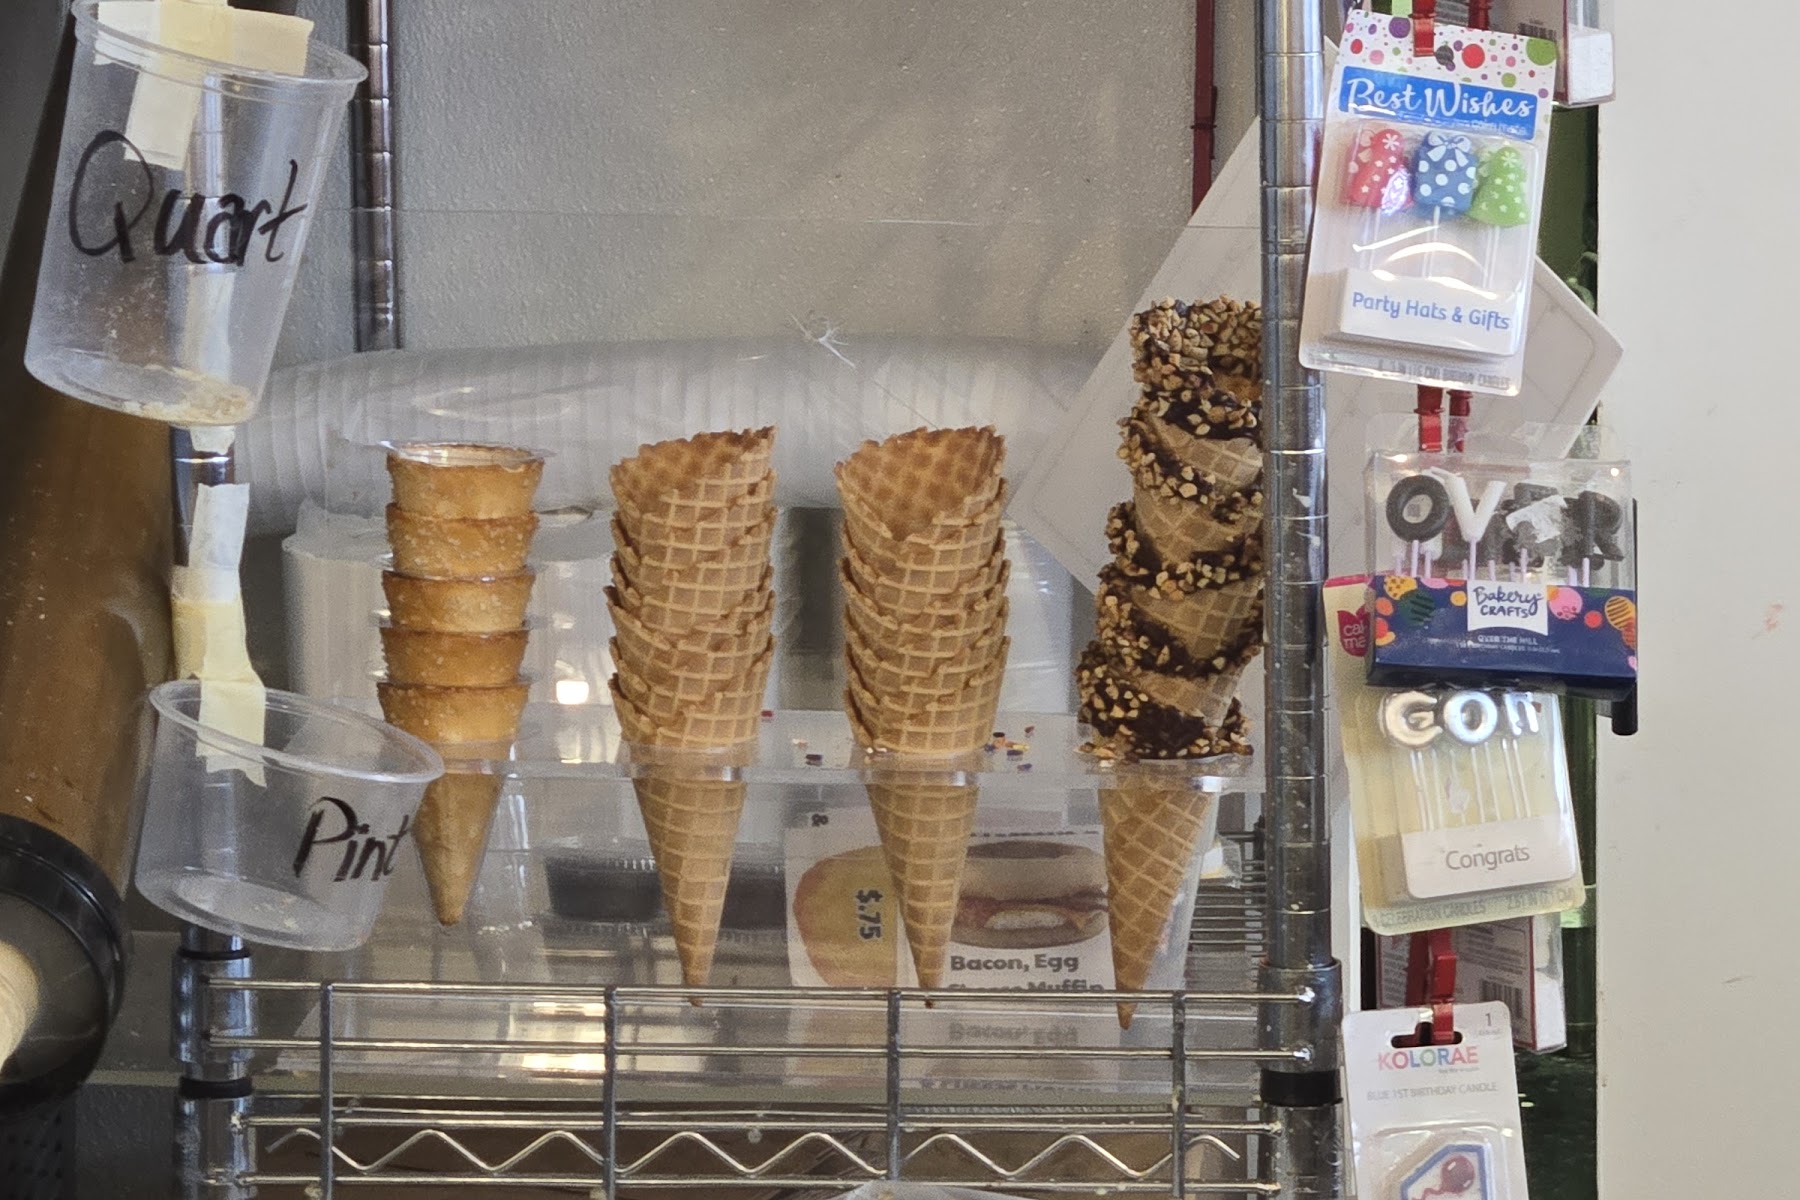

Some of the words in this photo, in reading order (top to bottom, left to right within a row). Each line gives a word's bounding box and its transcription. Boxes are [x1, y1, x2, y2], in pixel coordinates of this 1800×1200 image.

[1347, 77, 1423, 111] Best
[1424, 82, 1535, 117] Wishes
[69, 130, 309, 267] Quart
[1352, 291, 1401, 318] Party
[1406, 299, 1447, 323] Hats
[1451, 306, 1463, 323] &
[1468, 308, 1510, 330] Gifts
[1473, 586, 1543, 616] Bakery
[1480, 605, 1530, 618] CRAFTS
[293, 796, 411, 882] Pint
[1445, 845, 1530, 871] Congrats
[855, 889, 883, 940] $.75
[950, 955, 1030, 973] Bacon,
[1034, 954, 1080, 972] Egg
[1485, 1013, 1492, 1027] 1
[1378, 1046, 1479, 1070] KOLORAE
[1411, 1085, 1456, 1098] BIRTHDAY
[1460, 1081, 1498, 1094] CANDLE
